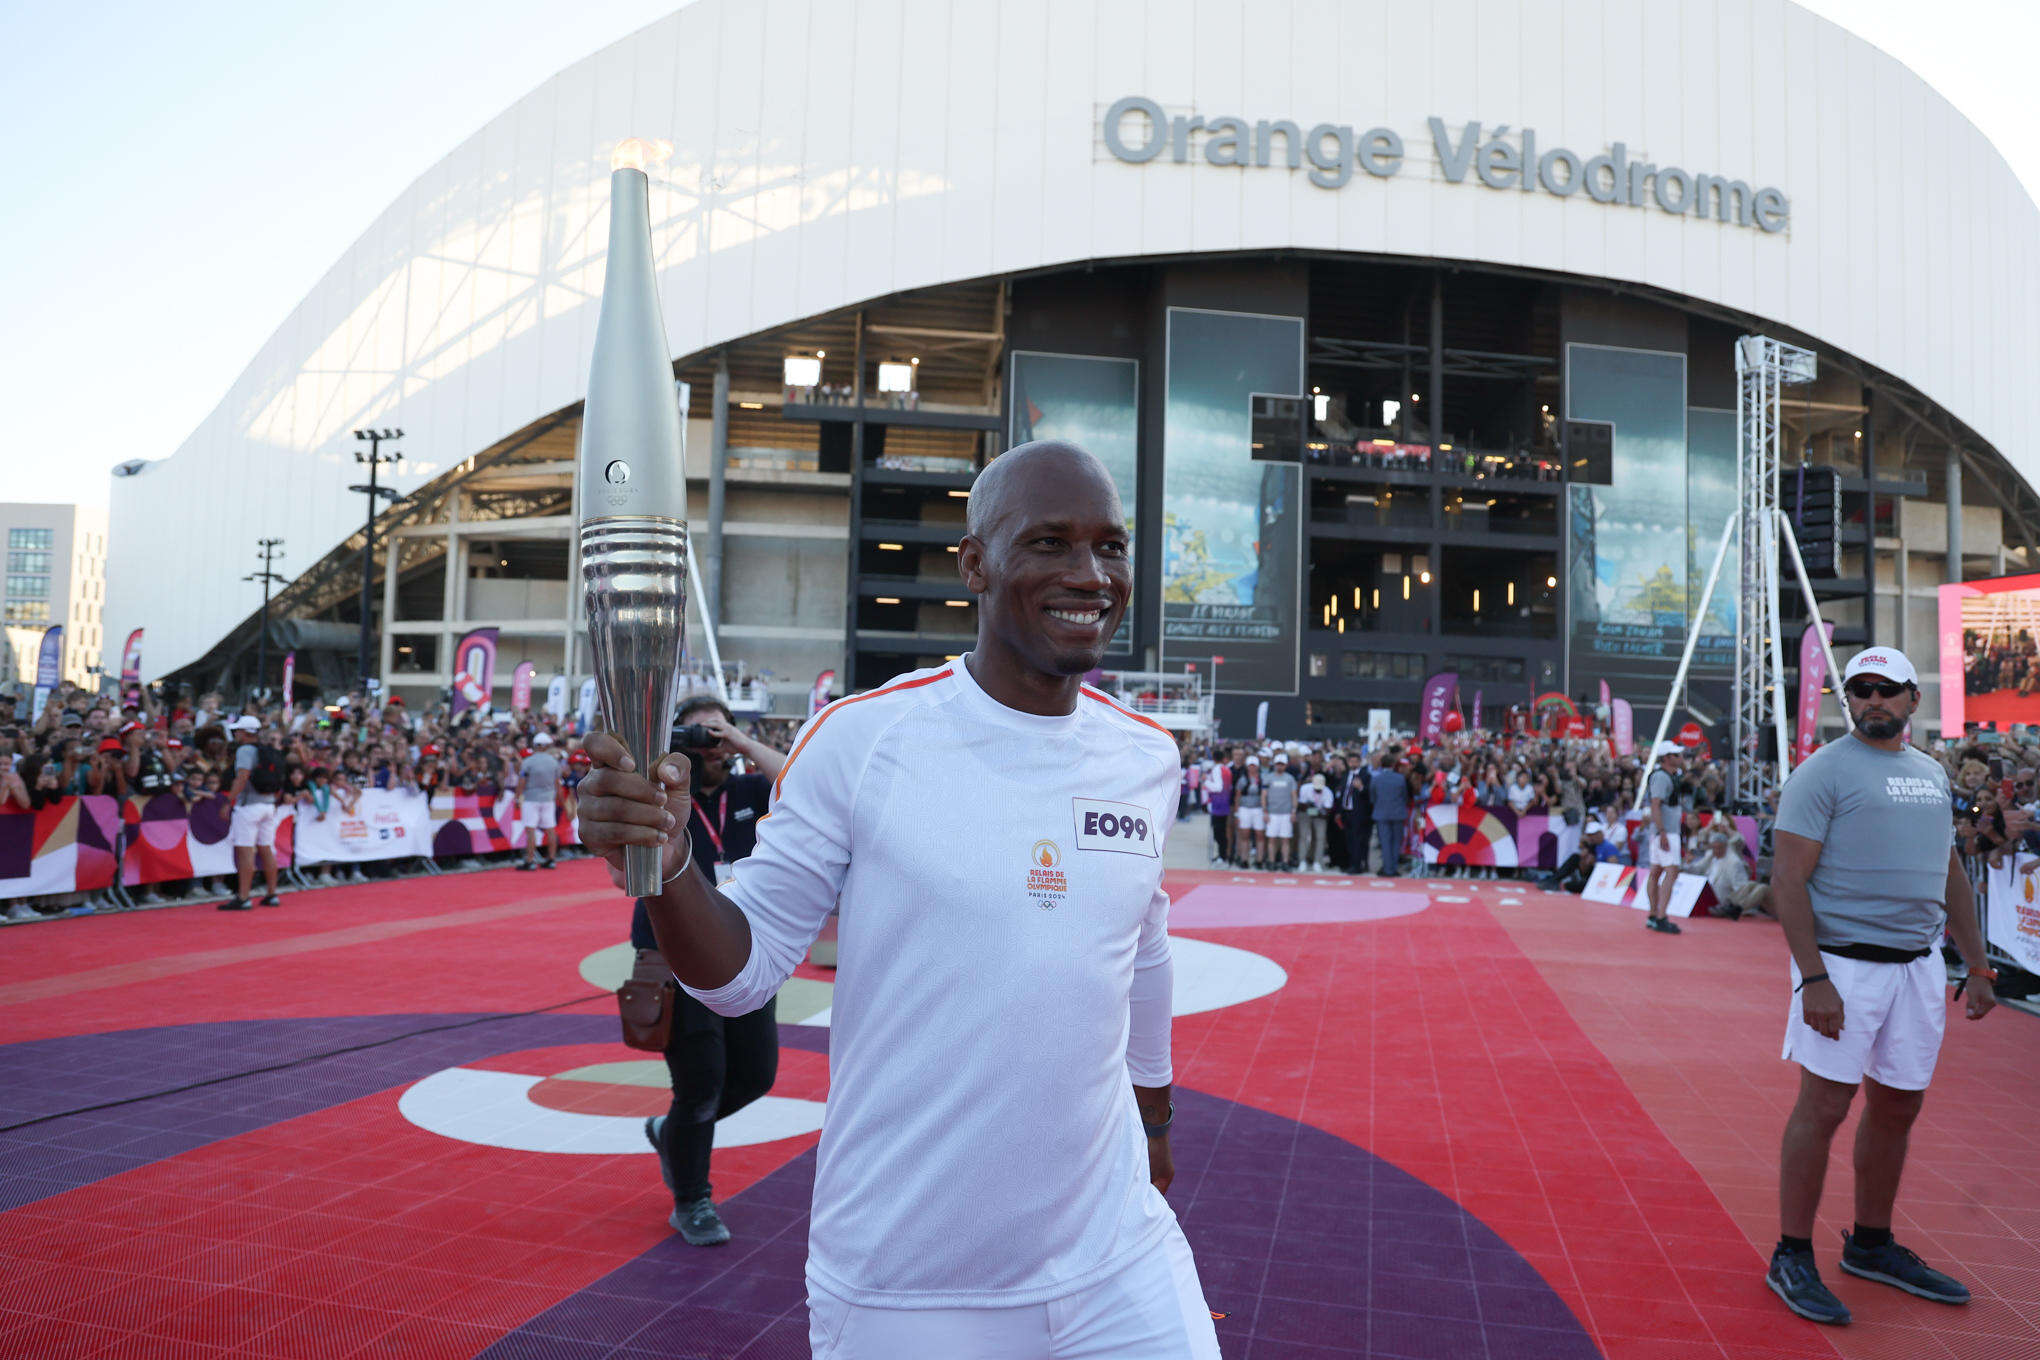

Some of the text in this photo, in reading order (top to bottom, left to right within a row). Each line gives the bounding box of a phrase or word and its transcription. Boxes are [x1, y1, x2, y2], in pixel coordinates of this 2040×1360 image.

[1103, 96, 1791, 234] Orange Vélodrome
[1029, 869, 1054, 877] RELAIS
[1037, 876, 1068, 885] FLAMME
[1027, 883, 1068, 892] OLYMPIQUE
[1028, 891, 1047, 899] PARIS
